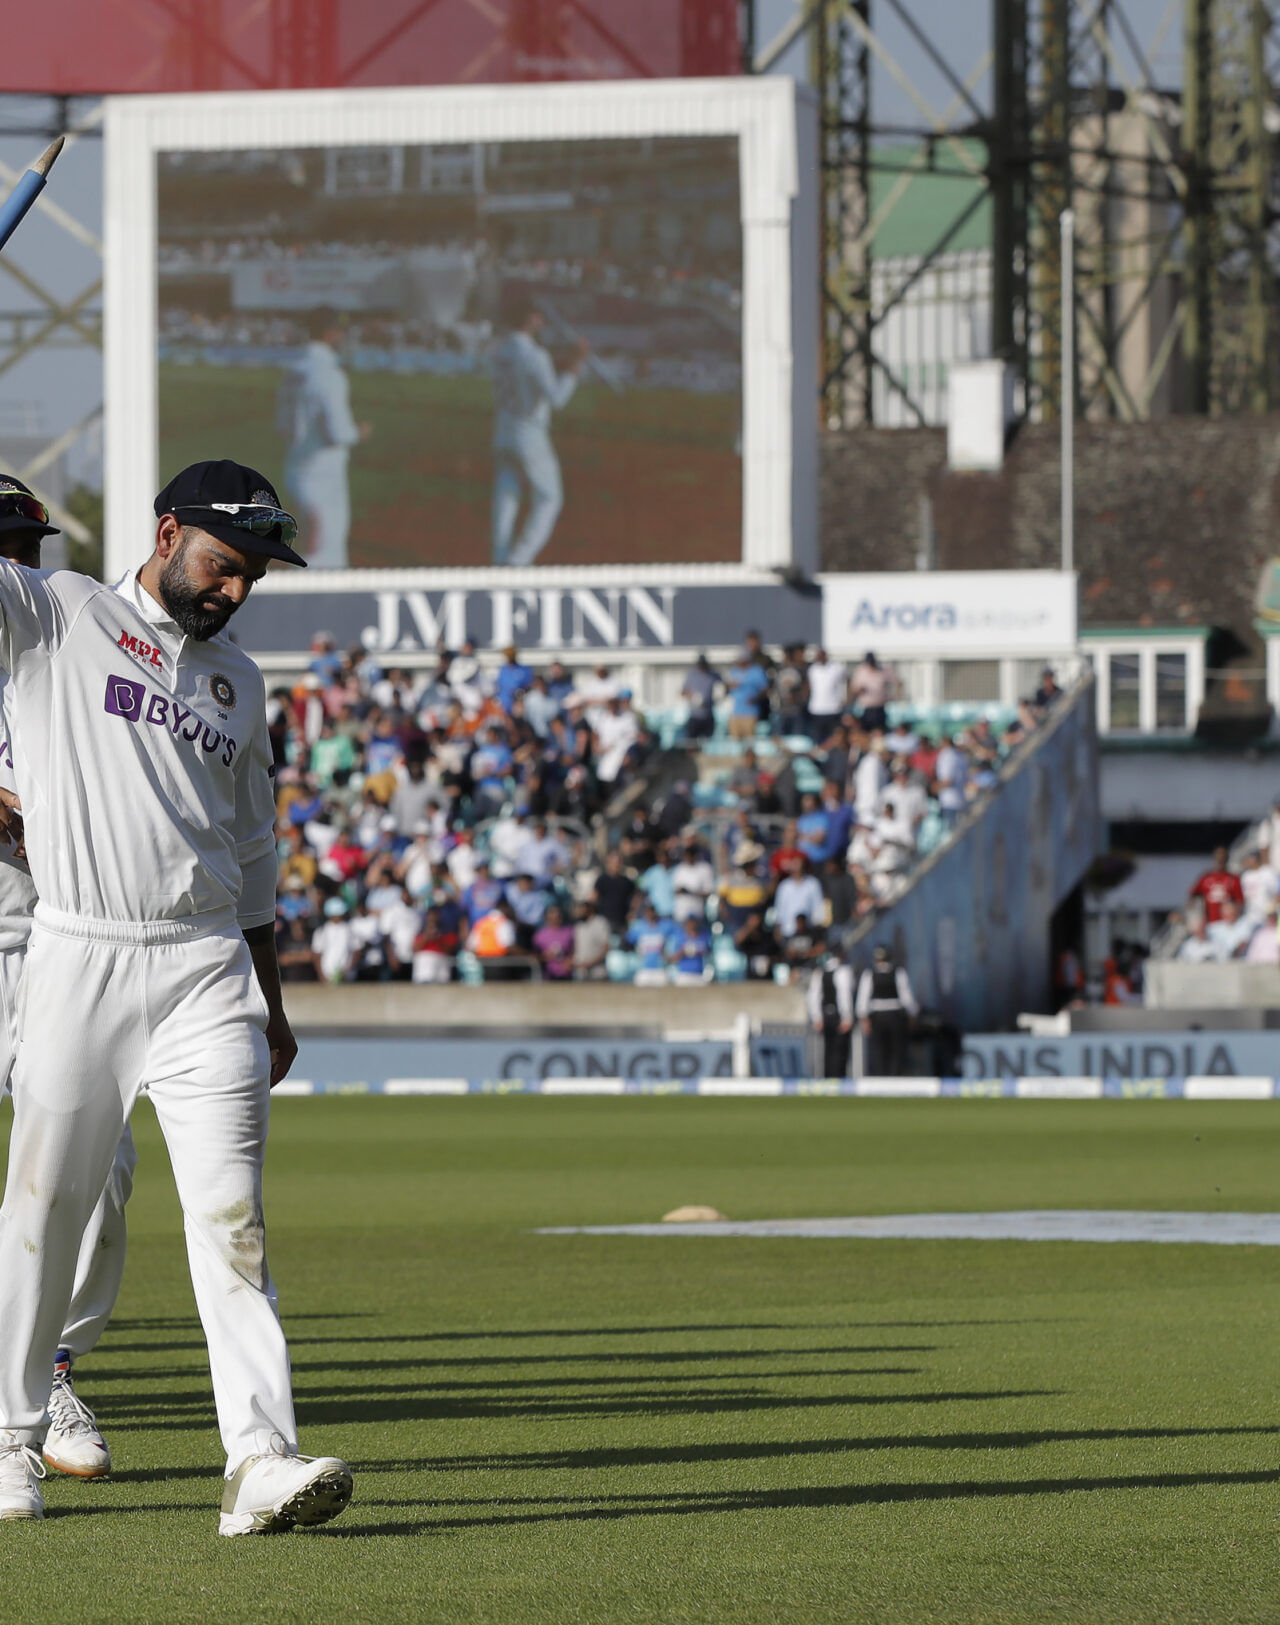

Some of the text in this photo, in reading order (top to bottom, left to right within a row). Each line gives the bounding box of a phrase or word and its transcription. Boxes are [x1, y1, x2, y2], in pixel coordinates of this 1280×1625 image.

[491, 586, 676, 648] FINN
[851, 600, 957, 630] Arora
[117, 629, 163, 667] MPL
[146, 694, 237, 767] BYJU'S
[1083, 1045, 1237, 1077] INDIA
